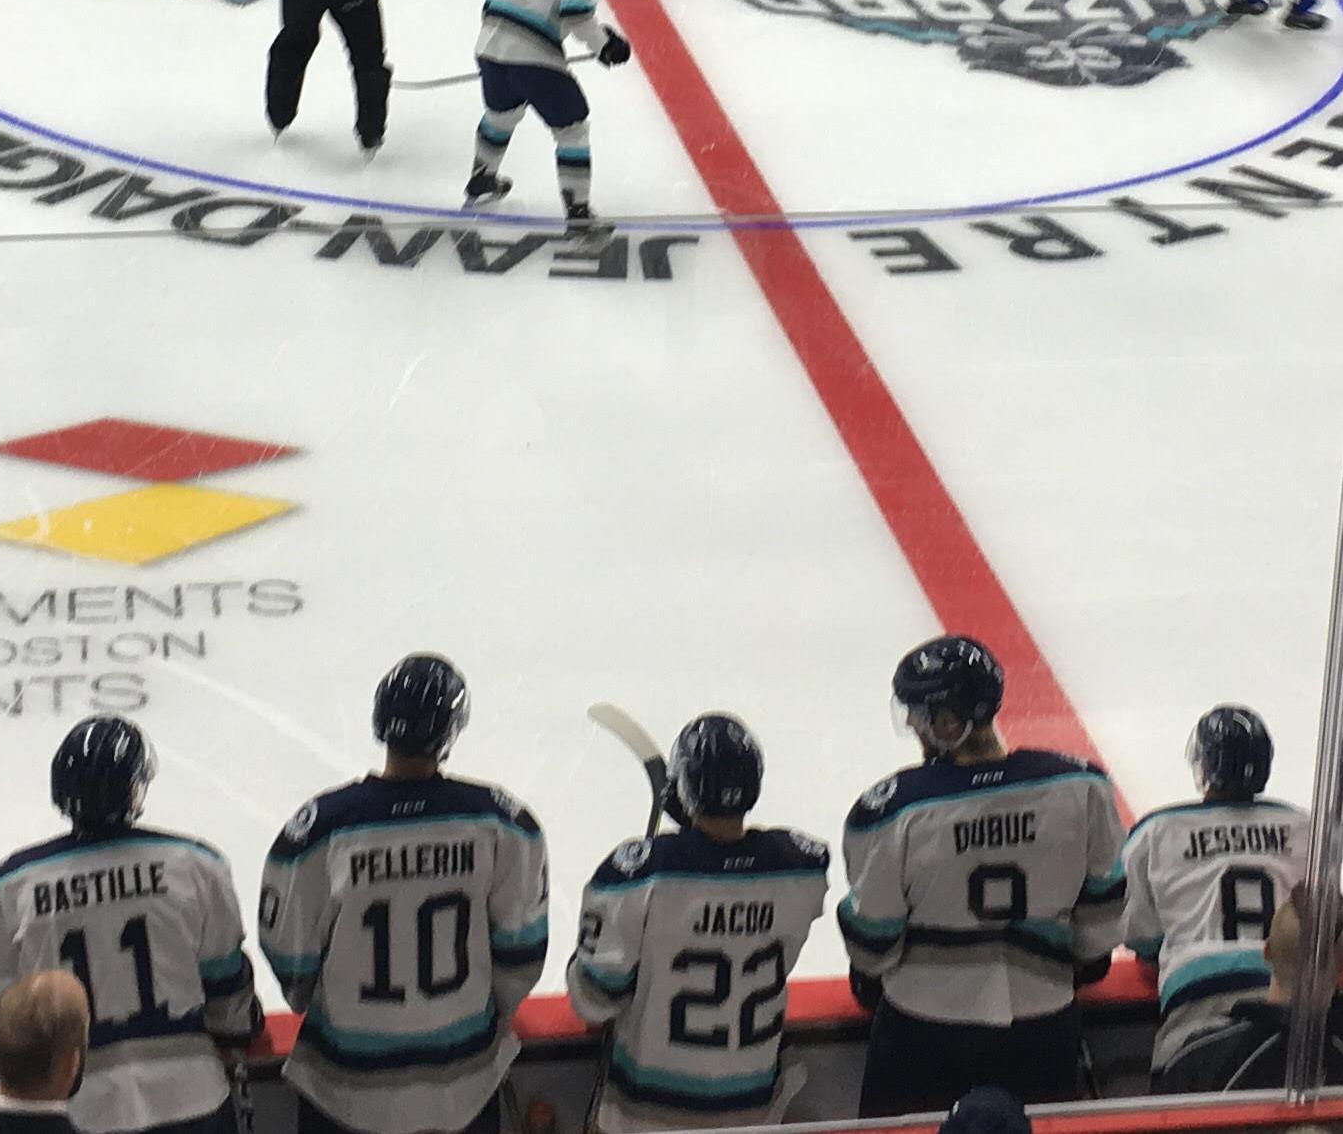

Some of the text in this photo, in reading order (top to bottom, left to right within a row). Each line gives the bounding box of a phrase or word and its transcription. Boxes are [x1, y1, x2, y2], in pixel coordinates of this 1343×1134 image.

[953, 812, 1037, 856] DUBUC
[1183, 823, 1294, 861] JESSOME
[33, 860, 167, 917] BASTILLE
[350, 841, 476, 887] PELLERIN
[692, 900, 775, 937] JACOB
[59, 915, 159, 1022] 11
[360, 890, 472, 1003] 10
[667, 940, 787, 1051] 22
